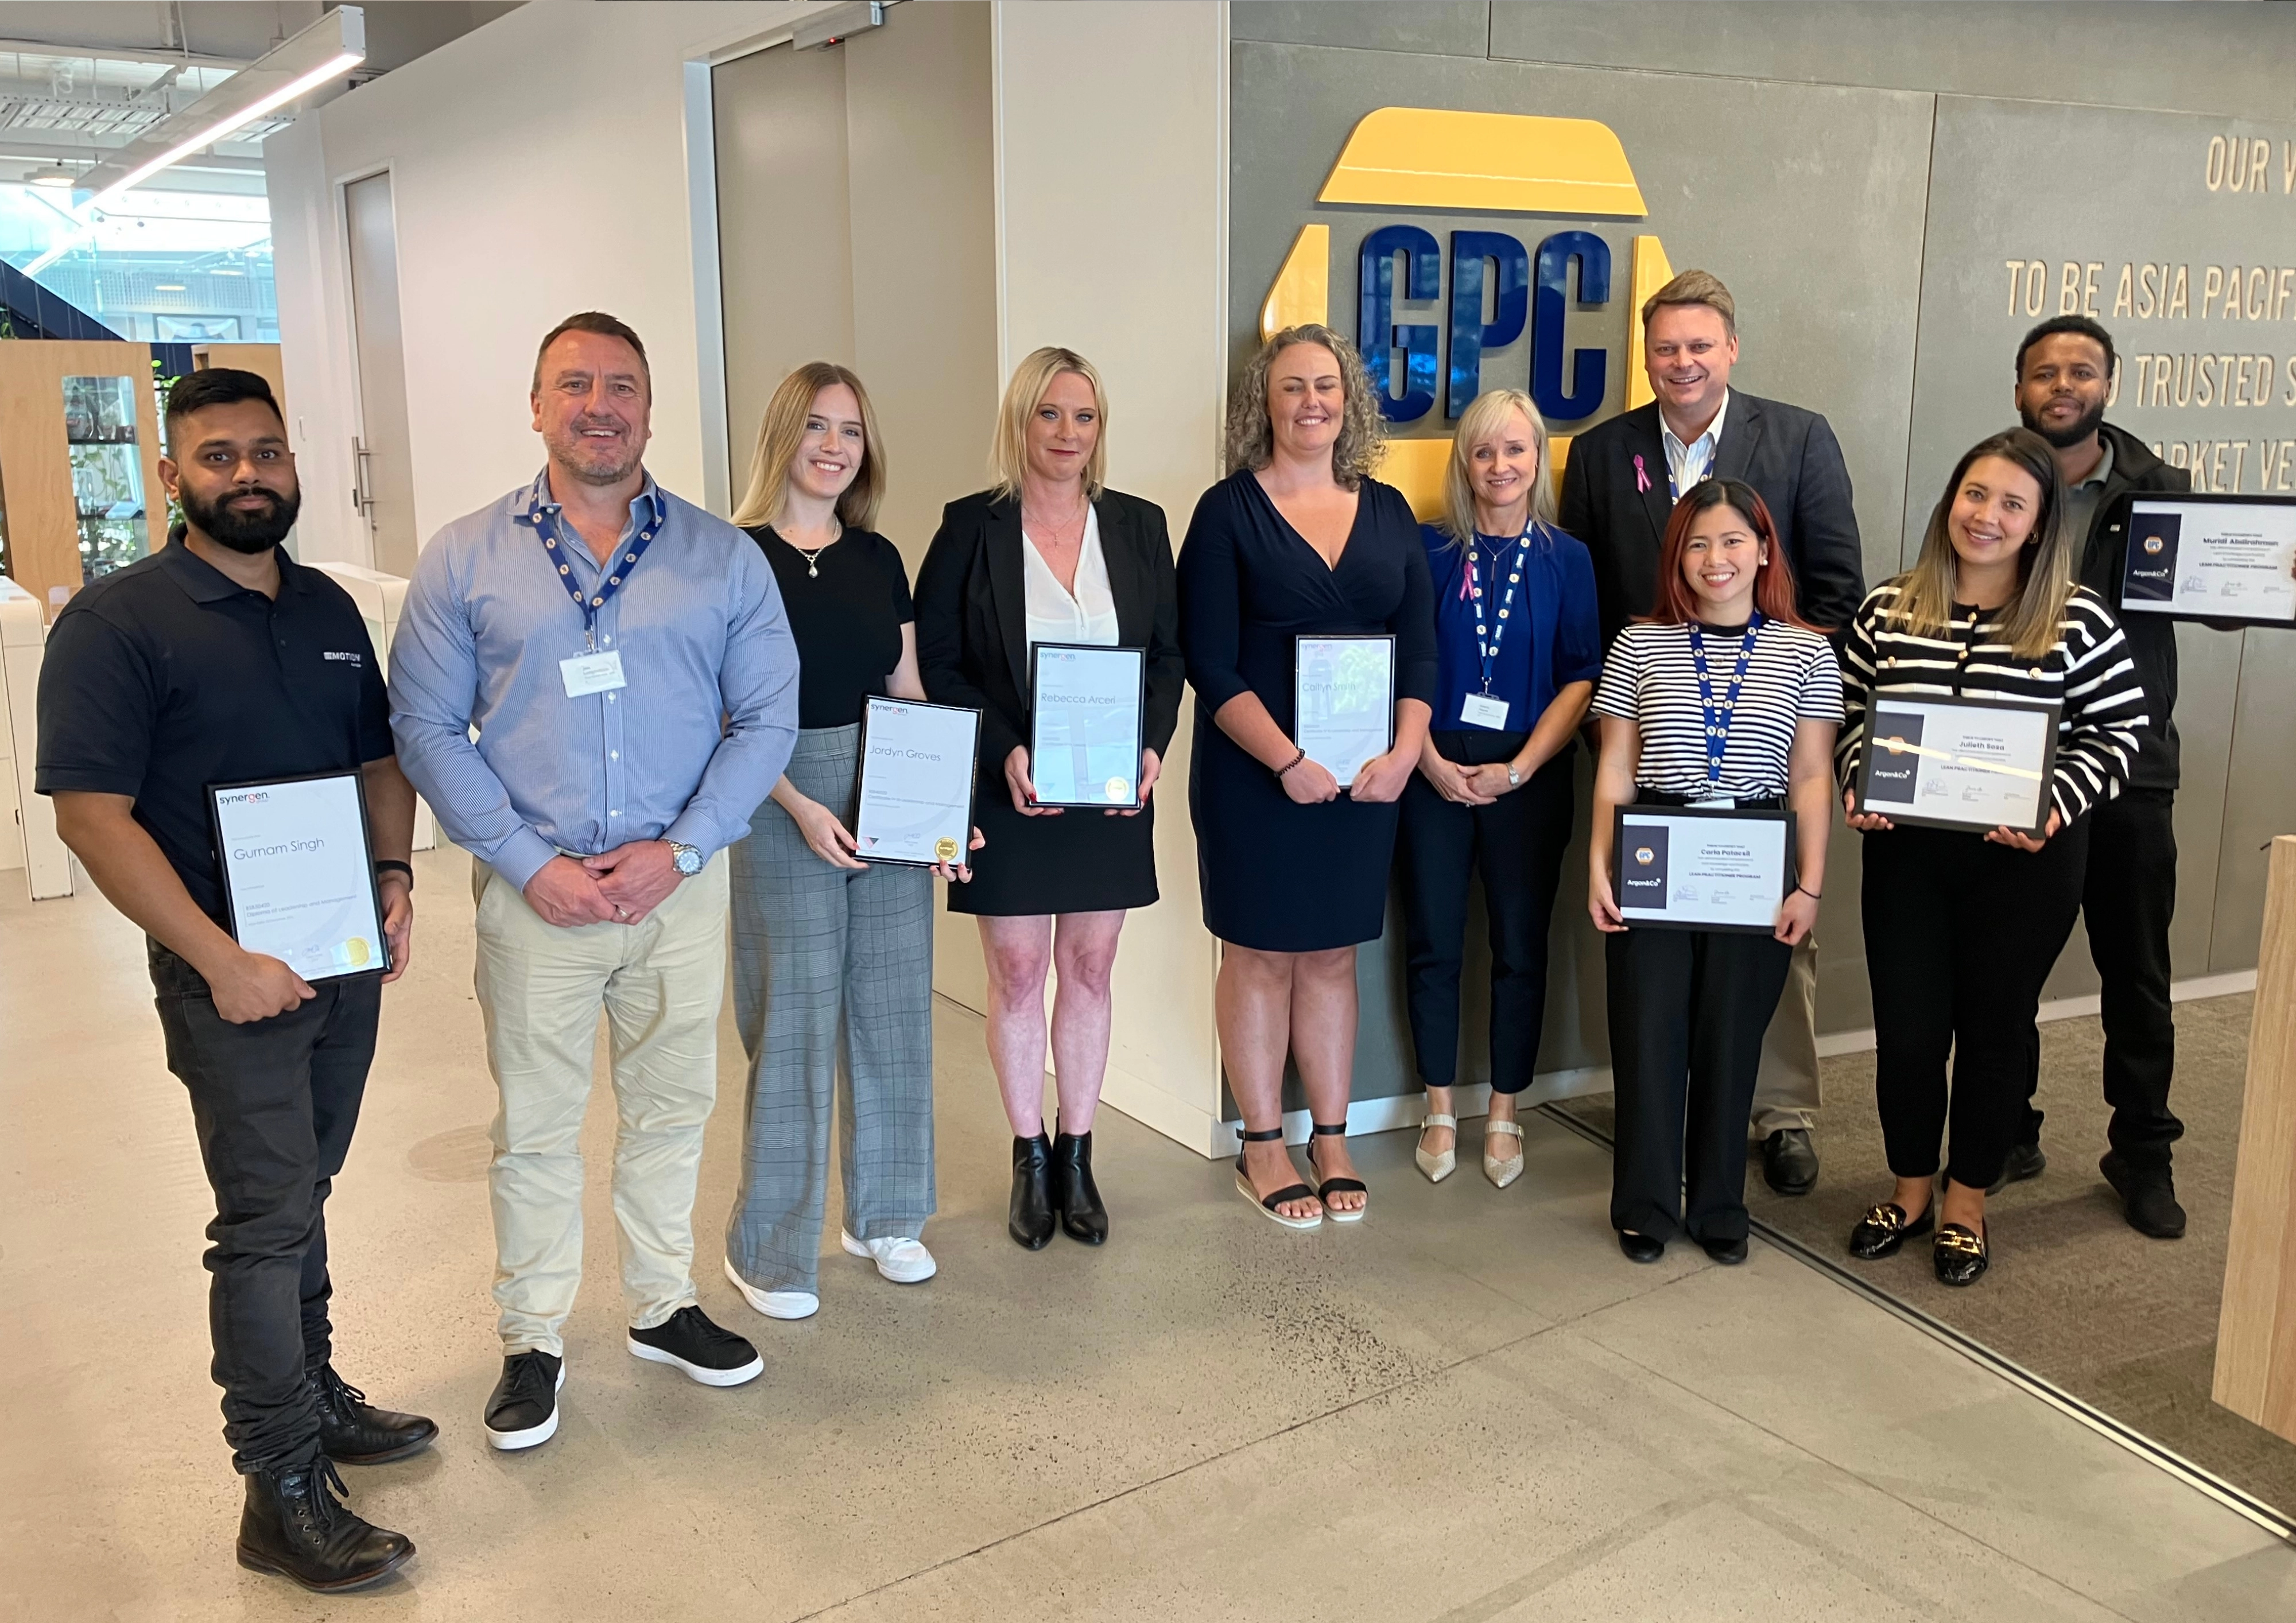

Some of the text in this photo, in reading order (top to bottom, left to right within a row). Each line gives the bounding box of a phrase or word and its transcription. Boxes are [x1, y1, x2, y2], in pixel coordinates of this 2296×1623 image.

[2206, 135, 2271, 193] OUR
[2006, 259, 2296, 321] TO BE ASIA PACIF
[1356, 224, 1611, 422] GPC
[2135, 353, 2274, 407] TRUSTED
[2261, 439, 2296, 491] VE
[1040, 651, 1075, 661] synergen
[1302, 682, 1356, 693] Caitlyn Smith
[1041, 693, 1115, 705] Rebecca Arceri
[871, 704, 907, 715] synergen
[870, 745, 941, 762] Jordyn Groves
[219, 791, 269, 806] synergen
[234, 838, 325, 860] Gurnam Singh
